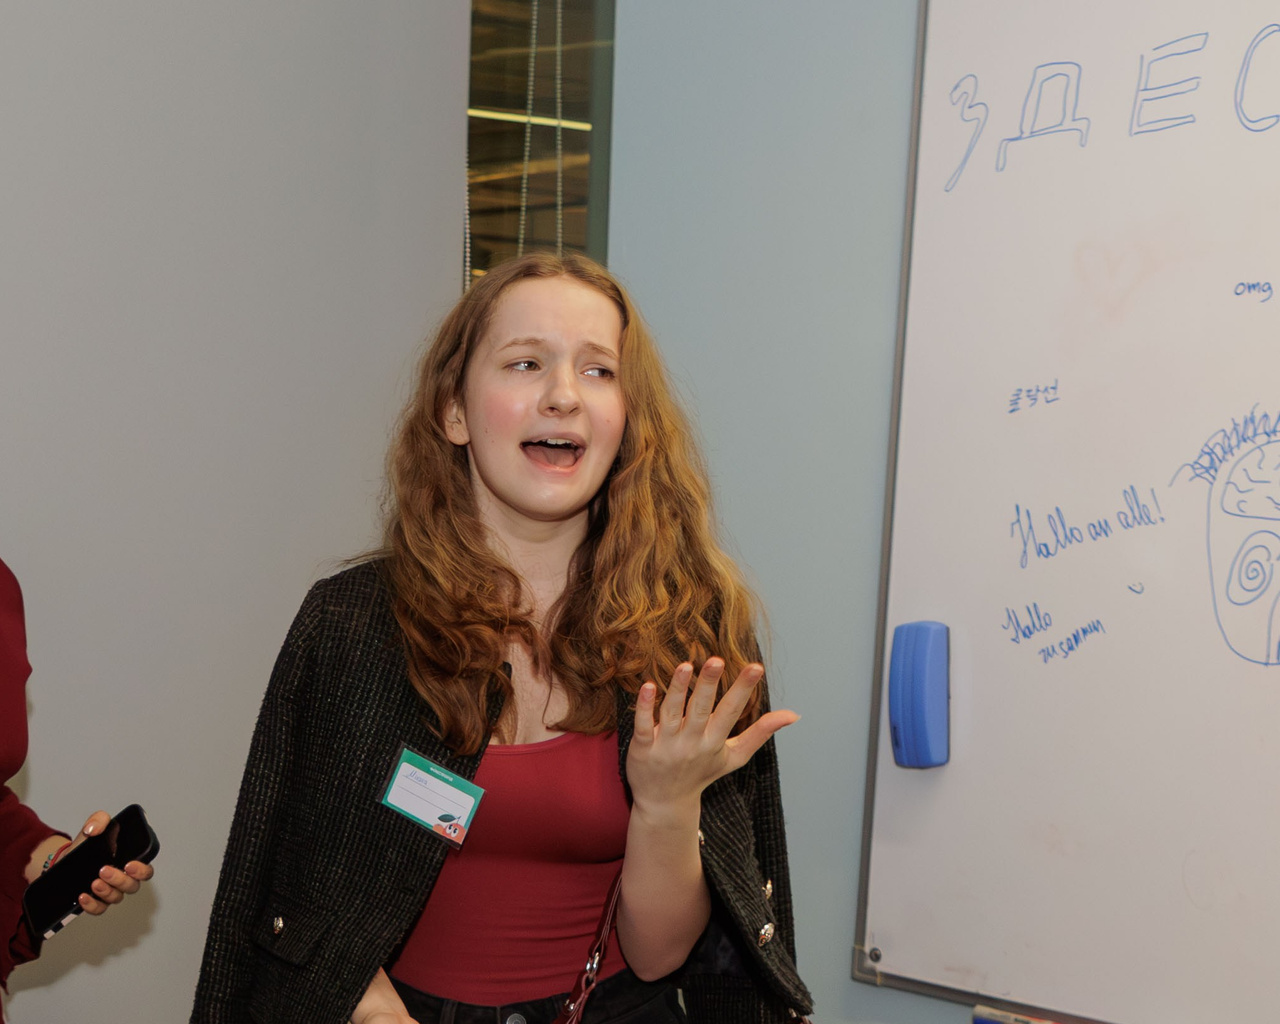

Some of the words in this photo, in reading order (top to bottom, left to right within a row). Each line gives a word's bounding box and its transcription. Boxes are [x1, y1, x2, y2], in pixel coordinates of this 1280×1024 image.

[1233, 280, 1273, 303] omg
[1011, 503, 1083, 569] Hallo
[1002, 602, 1052, 643] Hallo
